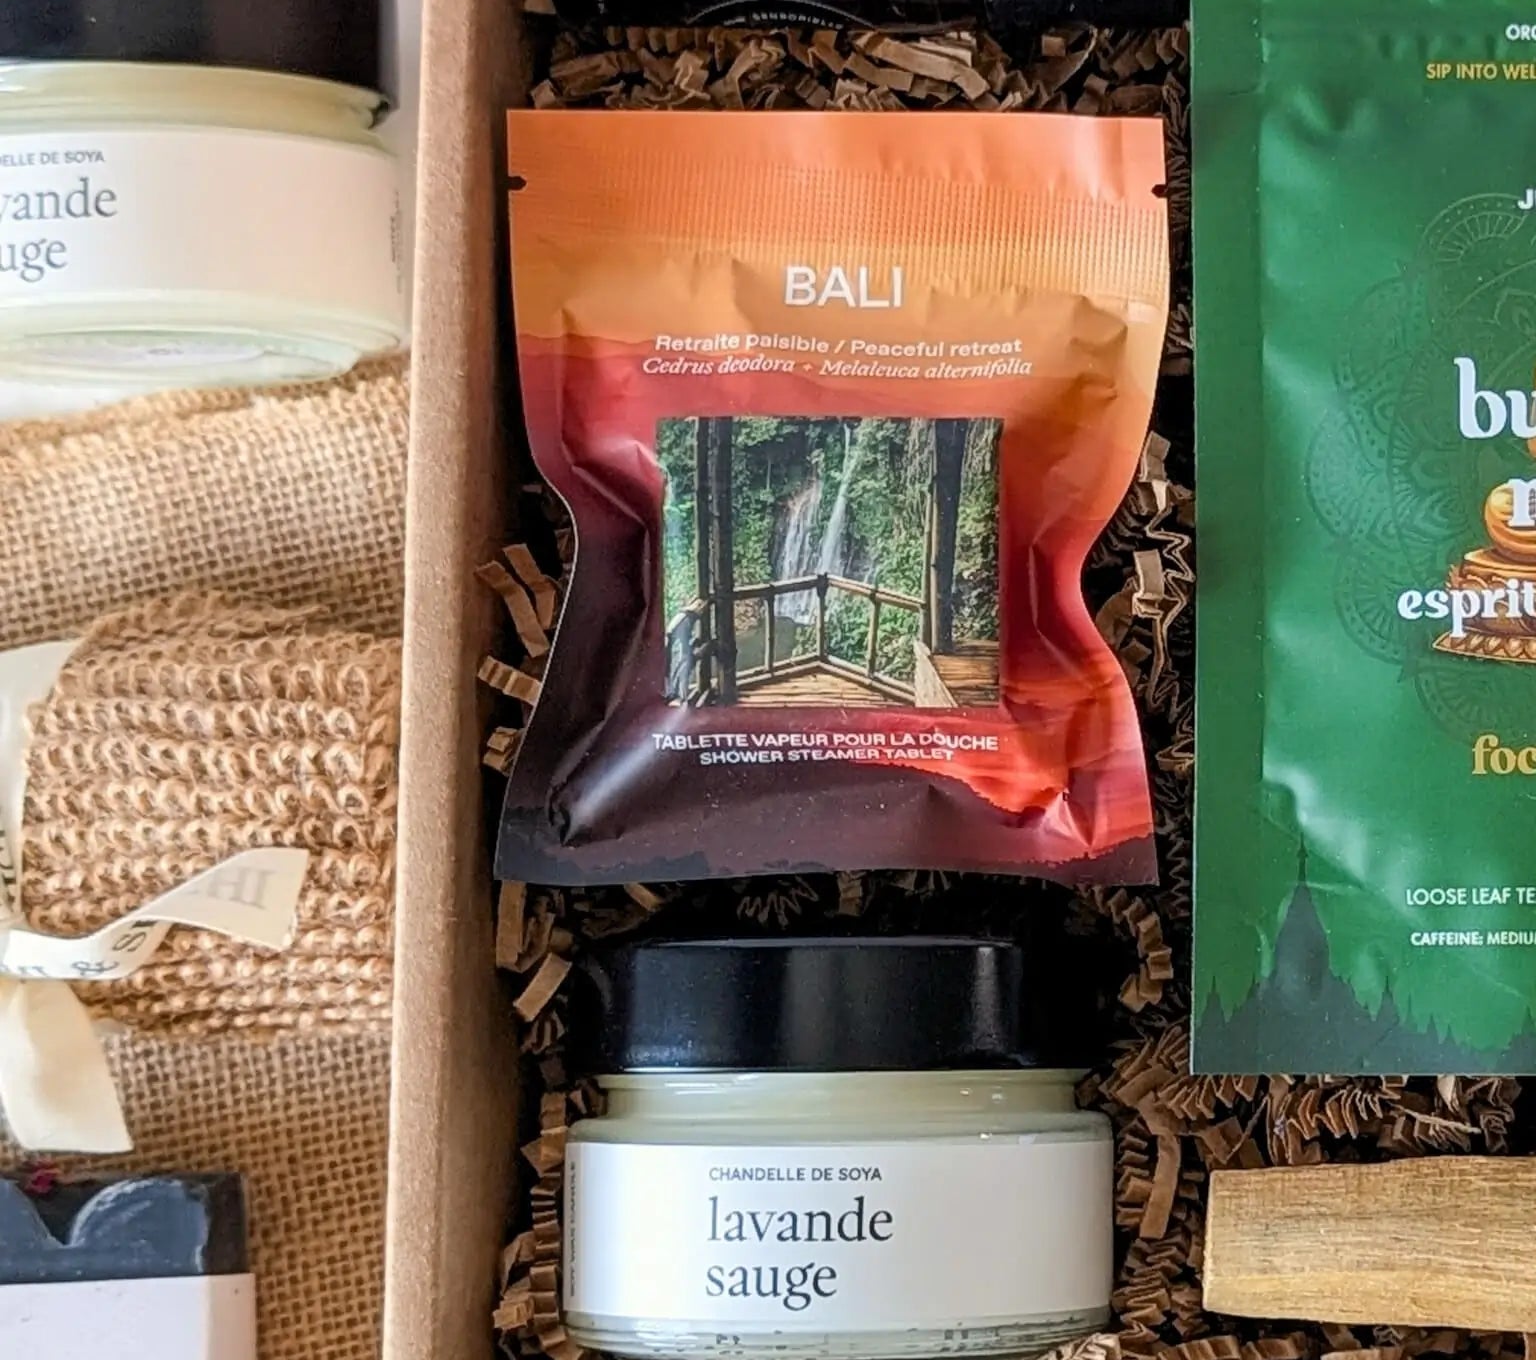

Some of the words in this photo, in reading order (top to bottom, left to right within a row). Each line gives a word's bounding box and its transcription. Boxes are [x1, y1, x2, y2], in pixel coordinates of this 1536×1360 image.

[1427, 63, 1451, 80] SIP
[1457, 63, 1497, 80] INTO
[40, 151, 60, 165] DE
[63, 150, 105, 165] SOYA
[784, 265, 903, 308] BALI
[655, 333, 740, 353] Retraite
[745, 333, 829, 354] paisible
[851, 339, 944, 356] Peaceful
[950, 339, 1022, 357] retreat
[643, 356, 714, 376] Cedrus
[718, 354, 795, 374] deodora
[820, 359, 919, 378] Melaleuca
[925, 359, 1032, 379] alternifolia
[653, 733, 748, 750] TABLETTE
[751, 734, 829, 748] VAPEUR
[833, 733, 886, 747] POUR
[890, 734, 915, 746] LA
[918, 733, 999, 752] DOUCHE
[700, 750, 784, 765] SHOWER
[788, 749, 880, 762] STEAMER
[884, 748, 954, 761] TABLET
[1406, 887, 1467, 906] LOOSE
[1472, 888, 1511, 906] LEAF
[1410, 931, 1483, 946] CAFFEINE:
[709, 1167, 806, 1182] CHANDELLE
[811, 1167, 833, 1181] DE
[838, 1167, 883, 1182] SOYA
[708, 1195, 893, 1242] lavande
[705, 1262, 838, 1311] sauge
